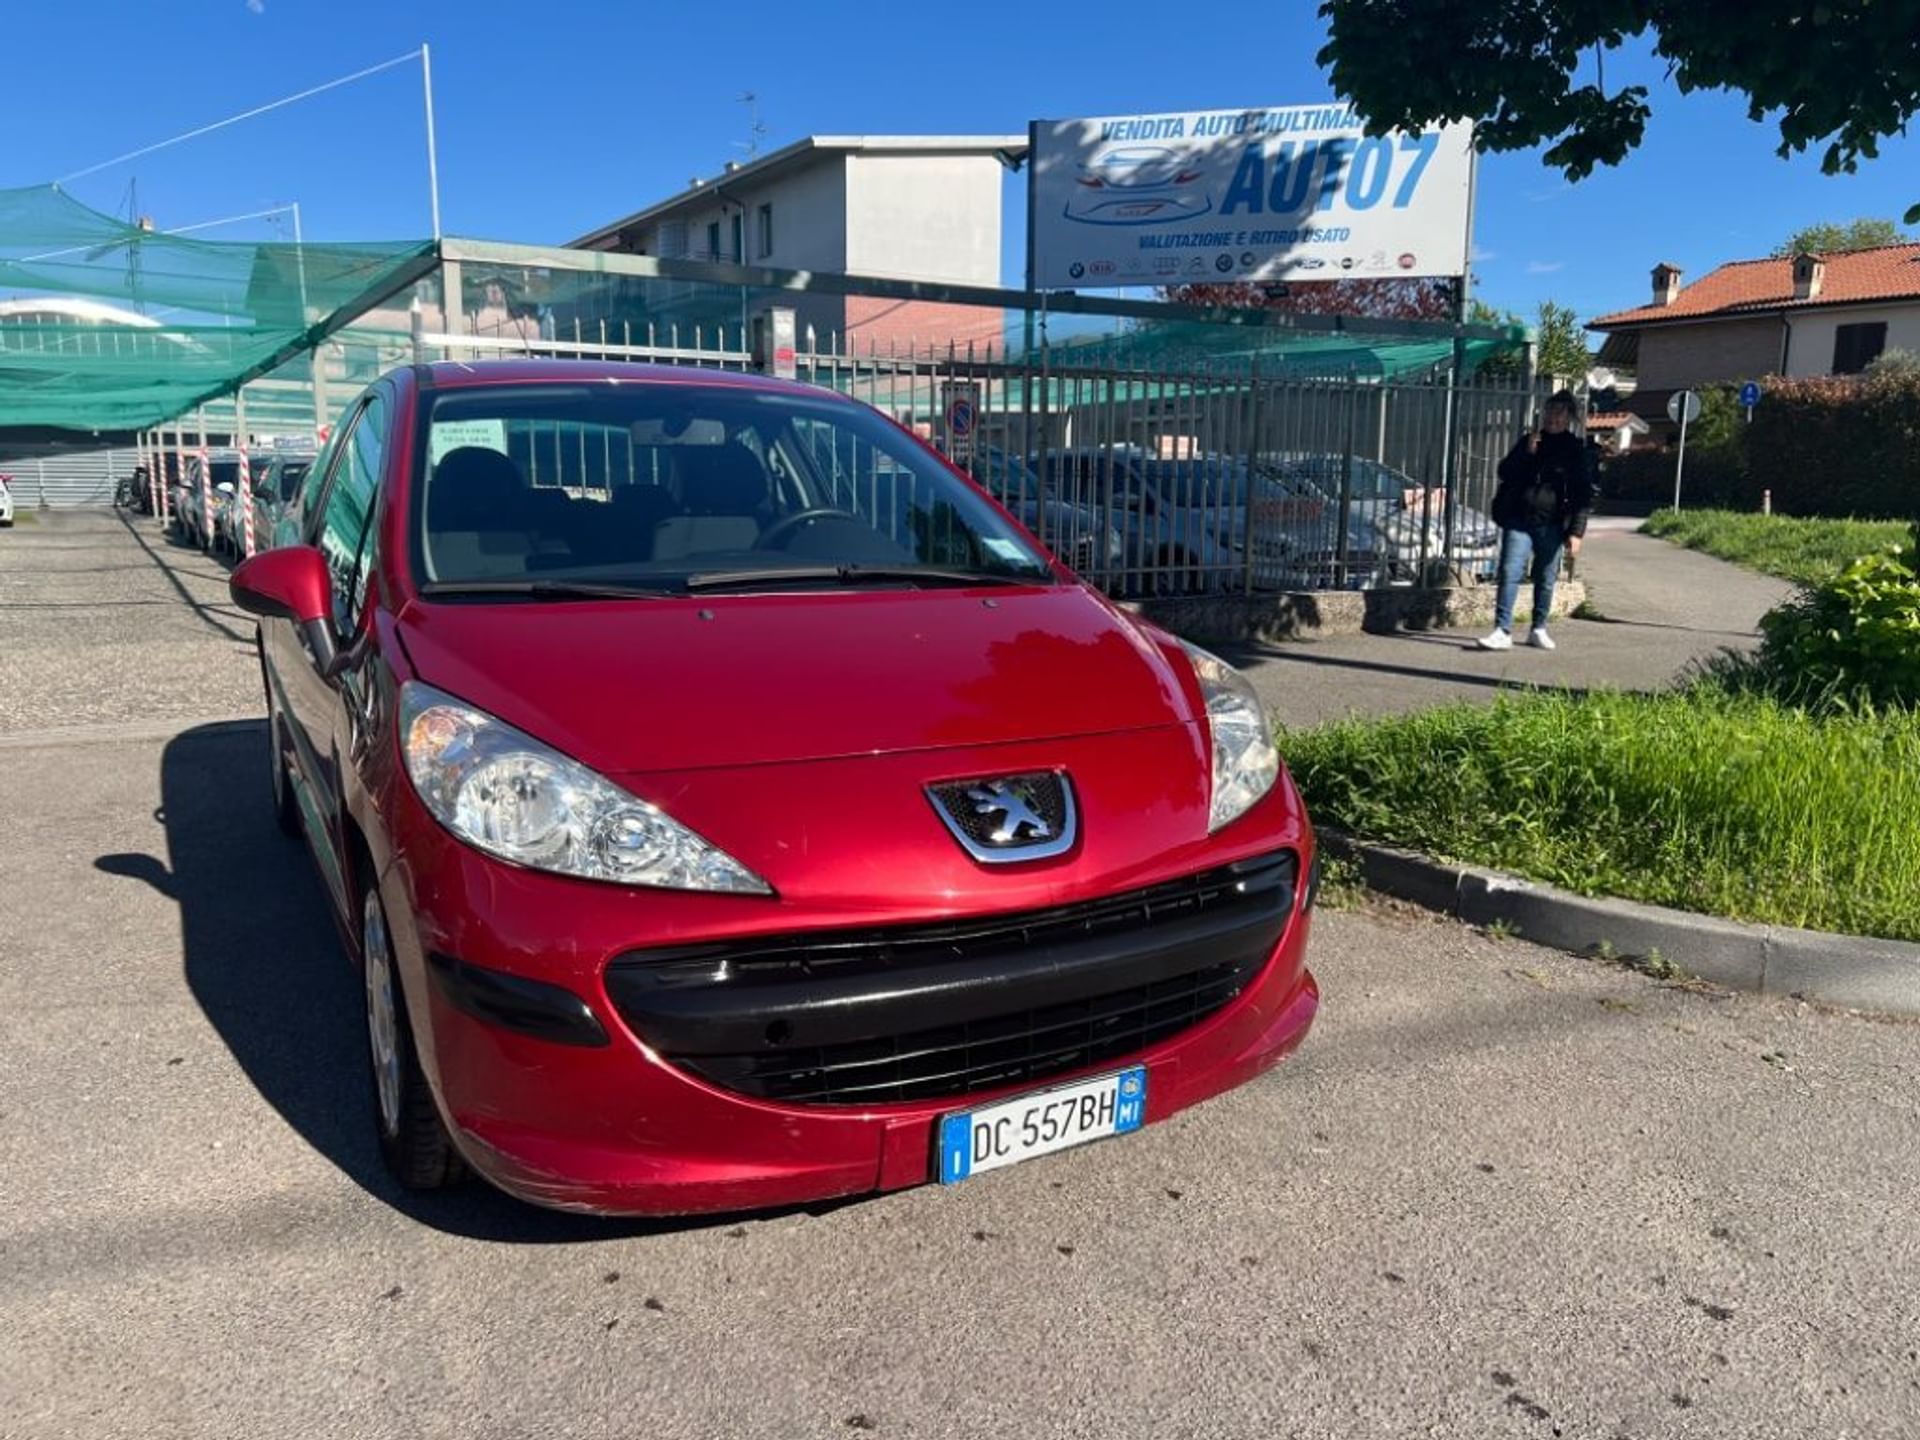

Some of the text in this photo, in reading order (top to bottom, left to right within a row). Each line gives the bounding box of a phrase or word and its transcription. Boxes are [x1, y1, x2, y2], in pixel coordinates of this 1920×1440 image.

[1101, 117, 1184, 140] VENDITA
[1192, 113, 1246, 136] AUTO
[1218, 133, 1440, 216] AUTO7
[1139, 227, 1350, 248] VALUTAZIONE E RITIRO USATO
[973, 1117, 1011, 1163] DC
[1022, 1088, 1116, 1148] 557BH
[1119, 1100, 1139, 1124] MI
